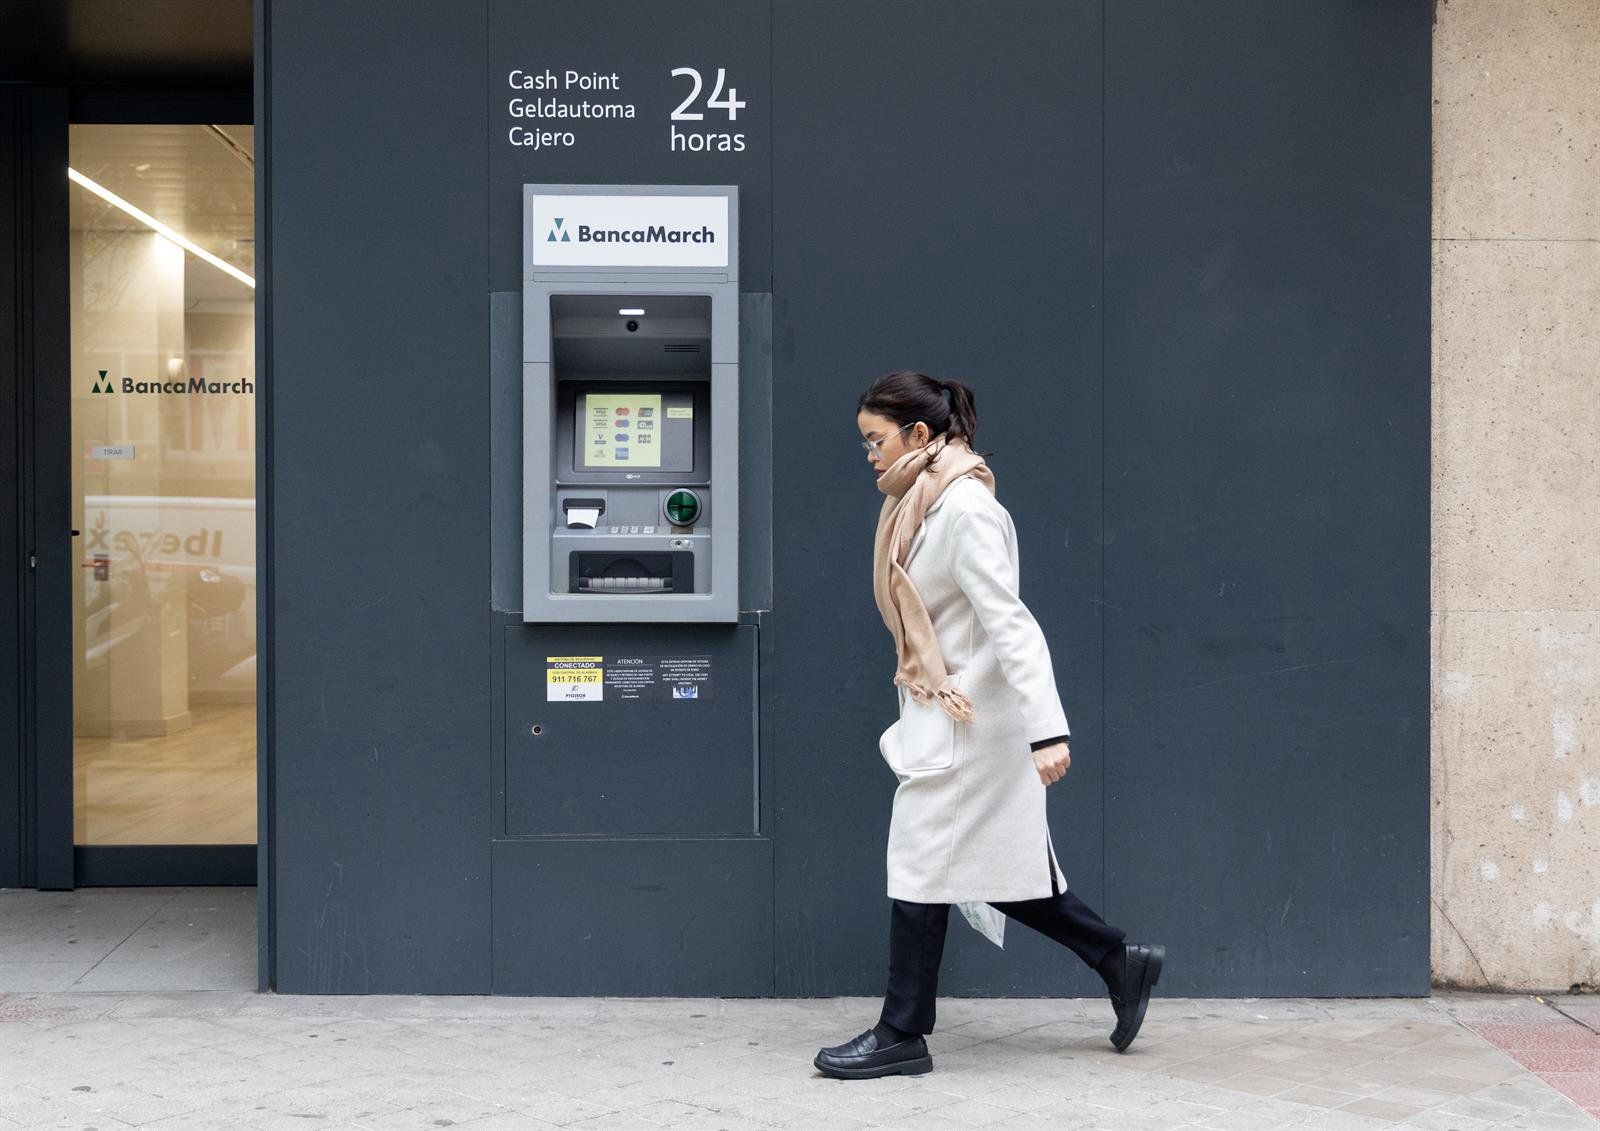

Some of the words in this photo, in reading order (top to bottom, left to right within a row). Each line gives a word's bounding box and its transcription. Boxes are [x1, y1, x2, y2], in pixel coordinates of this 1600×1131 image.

[508, 70, 557, 90] Cash
[565, 70, 620, 90] Point
[670, 67, 746, 121] 24
[508, 98, 636, 118] Geldautoma
[508, 126, 575, 150] Cajero
[671, 125, 746, 151] horas
[578, 225, 715, 244] BancaMarch
[122, 377, 253, 394] BancaMarch
[552, 675, 565, 683] 911
[568, 675, 582, 683] 716
[583, 675, 597, 683] 767
